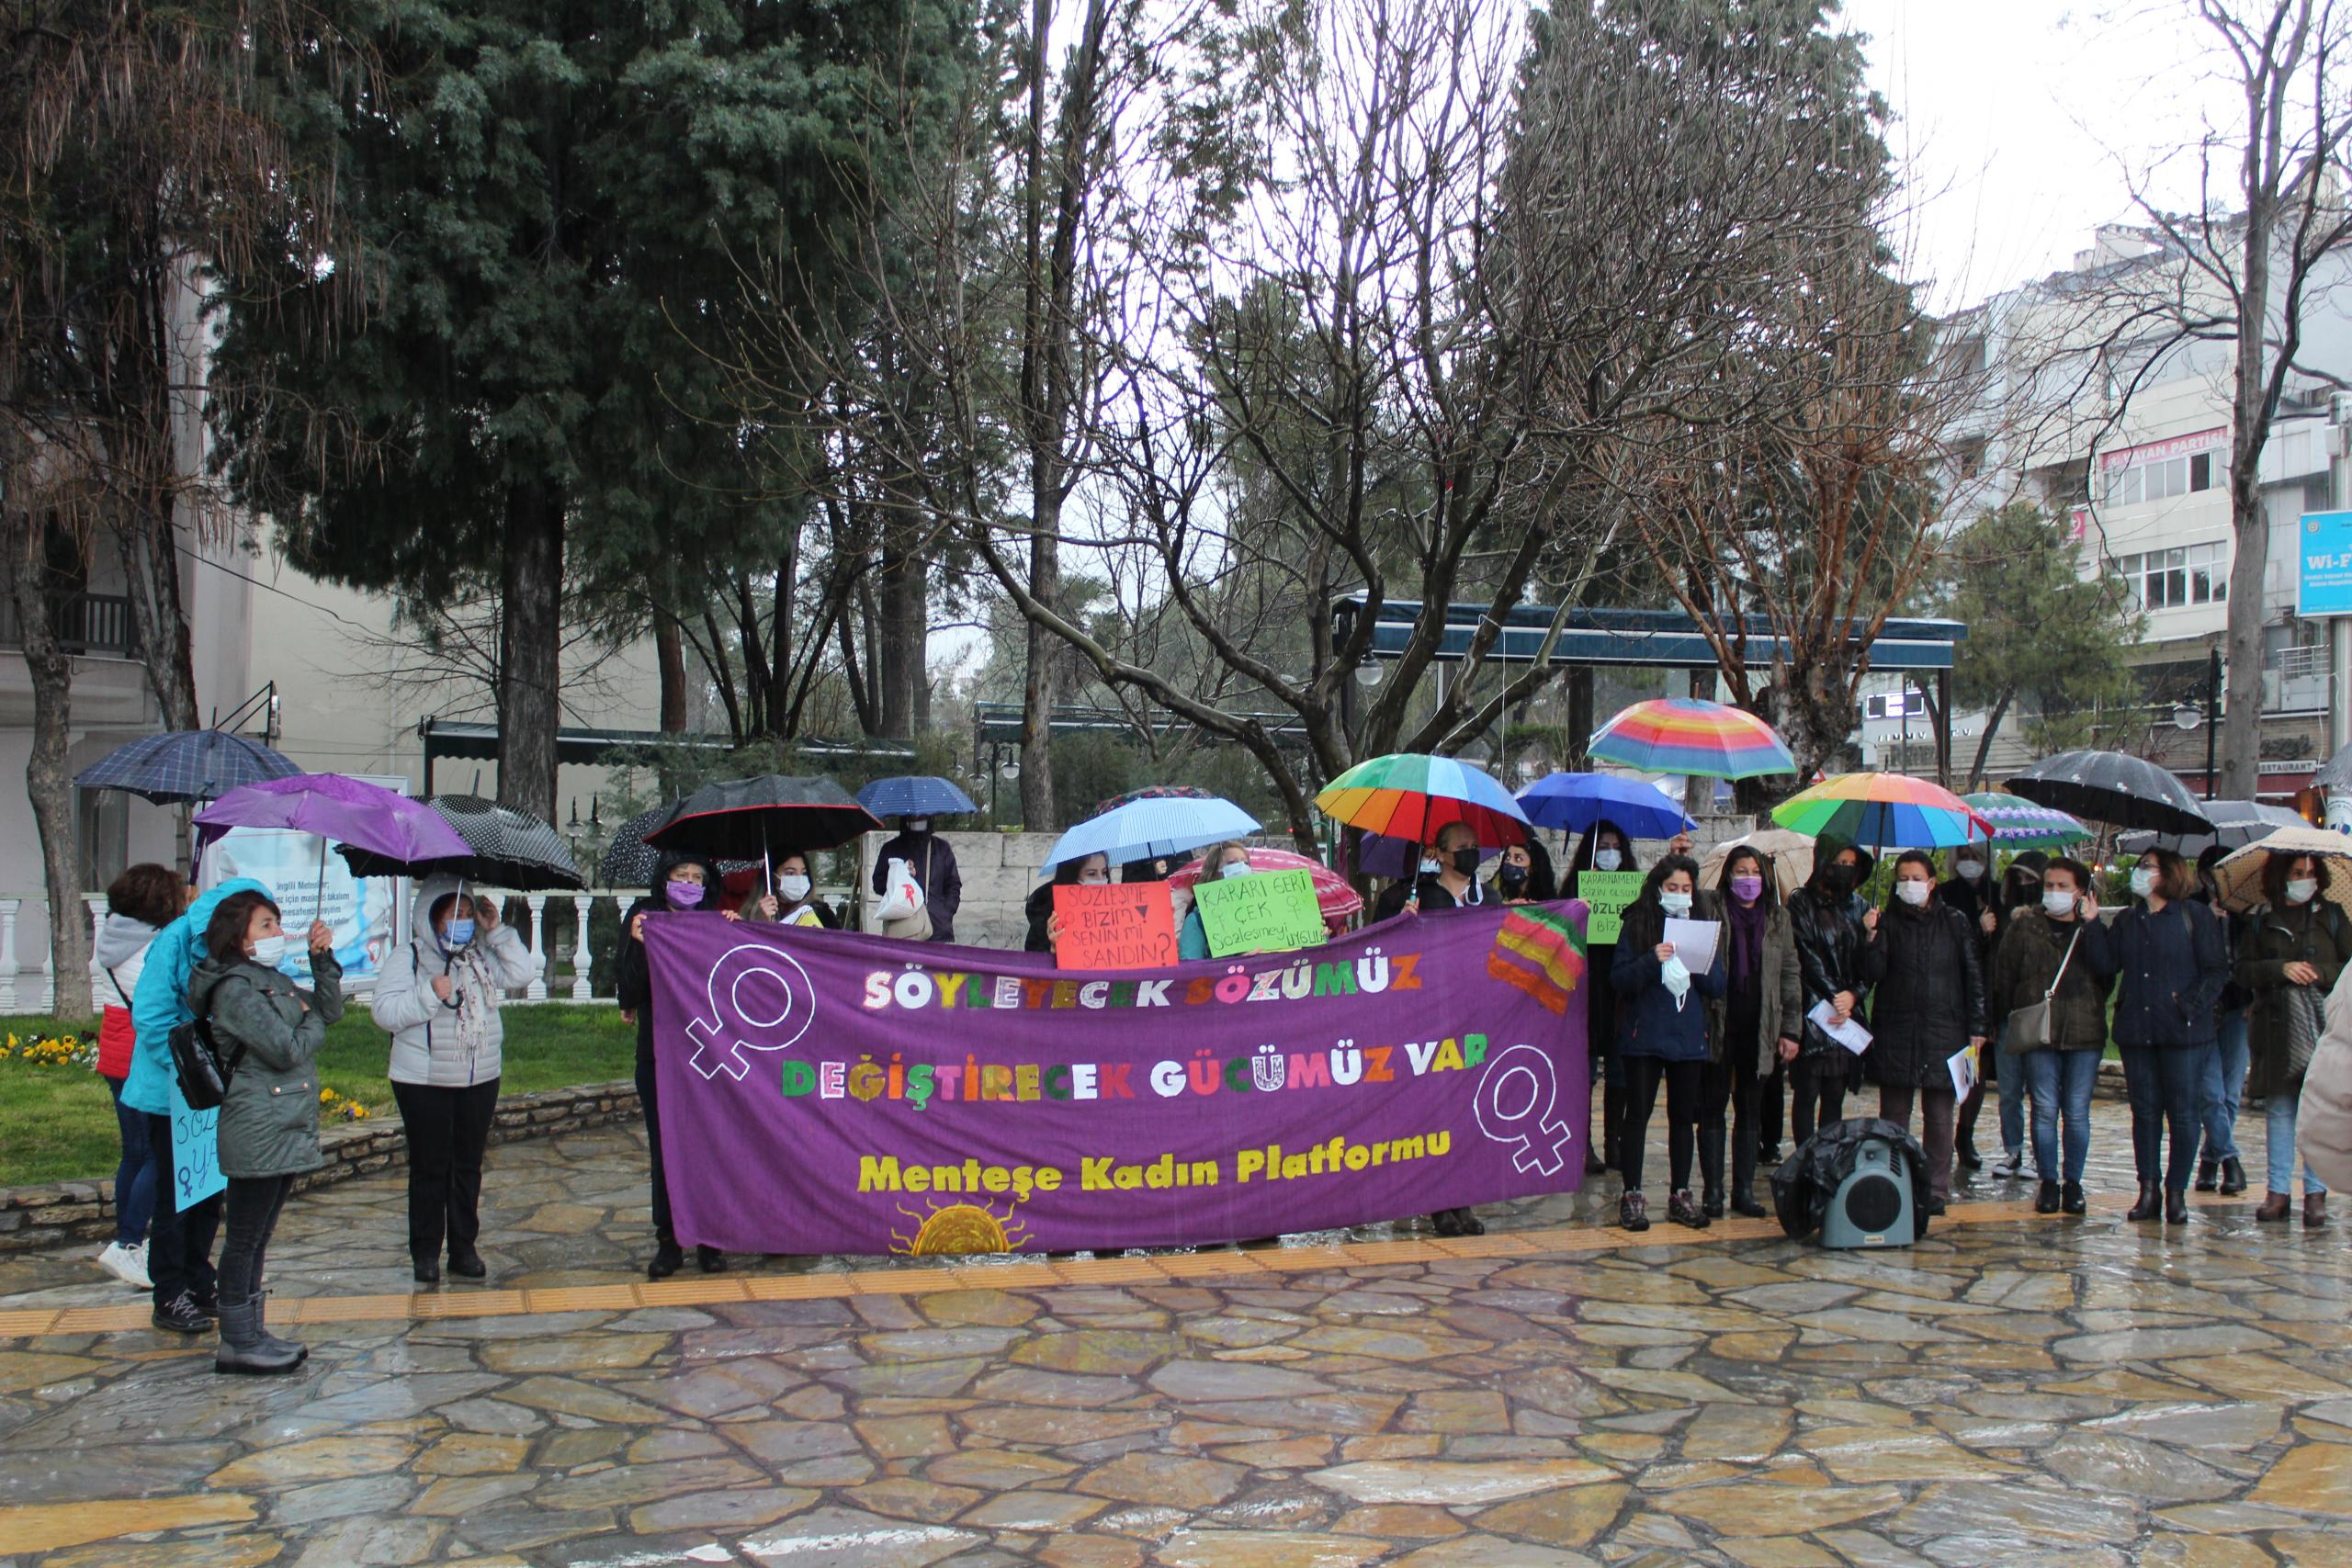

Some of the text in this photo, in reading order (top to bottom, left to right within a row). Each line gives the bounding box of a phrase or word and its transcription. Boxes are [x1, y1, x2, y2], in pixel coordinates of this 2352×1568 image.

[2123, 446, 2165, 461] VATAN
[2260, 762, 2312, 773] ESTAURANT
[1203, 880, 1267, 908] KARARI
[1610, 888, 1637, 897] OLSUN
[1235, 901, 1272, 925] ÇEK
[1083, 932, 1171, 968] SANDIN?
[864, 947, 1422, 1010] SÖYLEYECEK SÖZÜMÜZ
[782, 1033, 1488, 1111] DEĞİŞTİRECEK GÜCÜMÜZ VAR
[857, 1131, 1451, 1202] Menteşe Kadın Platformu
